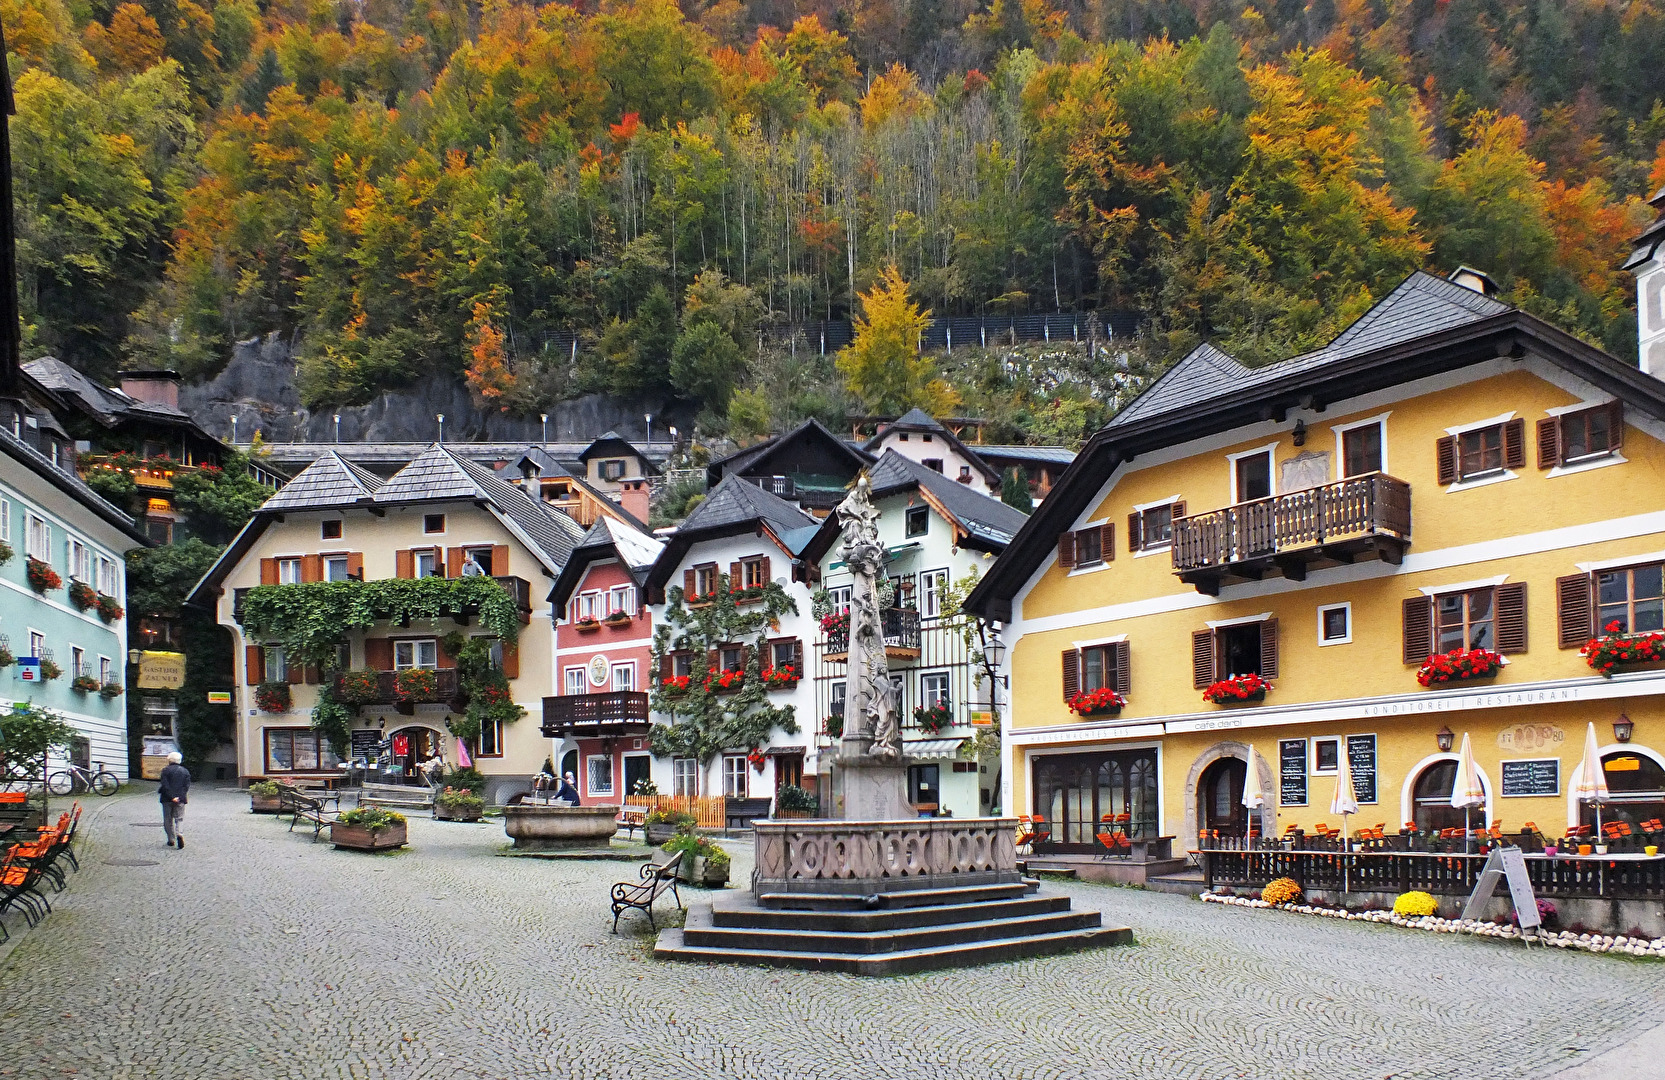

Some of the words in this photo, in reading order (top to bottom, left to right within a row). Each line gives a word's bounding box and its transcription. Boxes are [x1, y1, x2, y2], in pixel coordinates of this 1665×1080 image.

[1364, 701, 1450, 715] KONDITOREI
[1477, 689, 1579, 706] RESTAURANT
[1030, 731, 1107, 743] HAUSGEMACHTES
[1114, 728, 1129, 737] EIS
[1553, 731, 1564, 742] 80
